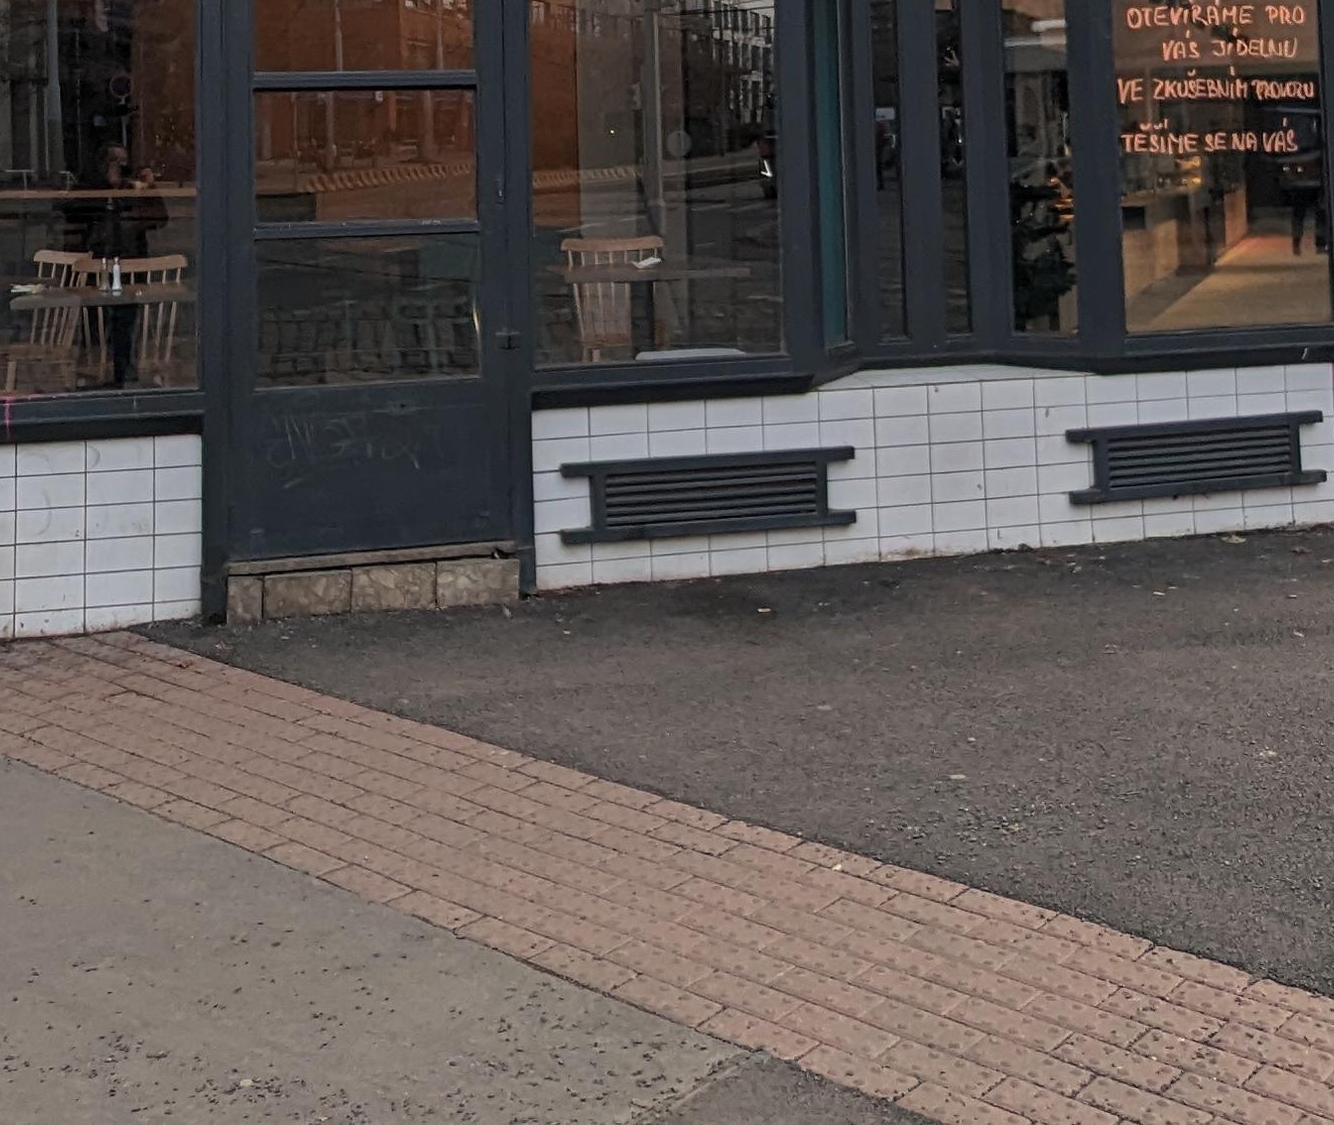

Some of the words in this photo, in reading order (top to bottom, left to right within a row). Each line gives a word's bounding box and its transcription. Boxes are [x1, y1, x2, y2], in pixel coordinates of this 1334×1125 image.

[1265, 4, 1305, 25] PRO
[1162, 30, 1200, 61] VÁS
[1212, 27, 1299, 59] JÍDELNU
[1117, 78, 1144, 104] VE
[1153, 65, 1248, 100] ZKUŠEBNÍM
[1120, 118, 1199, 155] TĚŠÍME
[1204, 133, 1226, 153] SE
[1232, 133, 1257, 153] NA
[1263, 117, 1299, 154] VÁS
